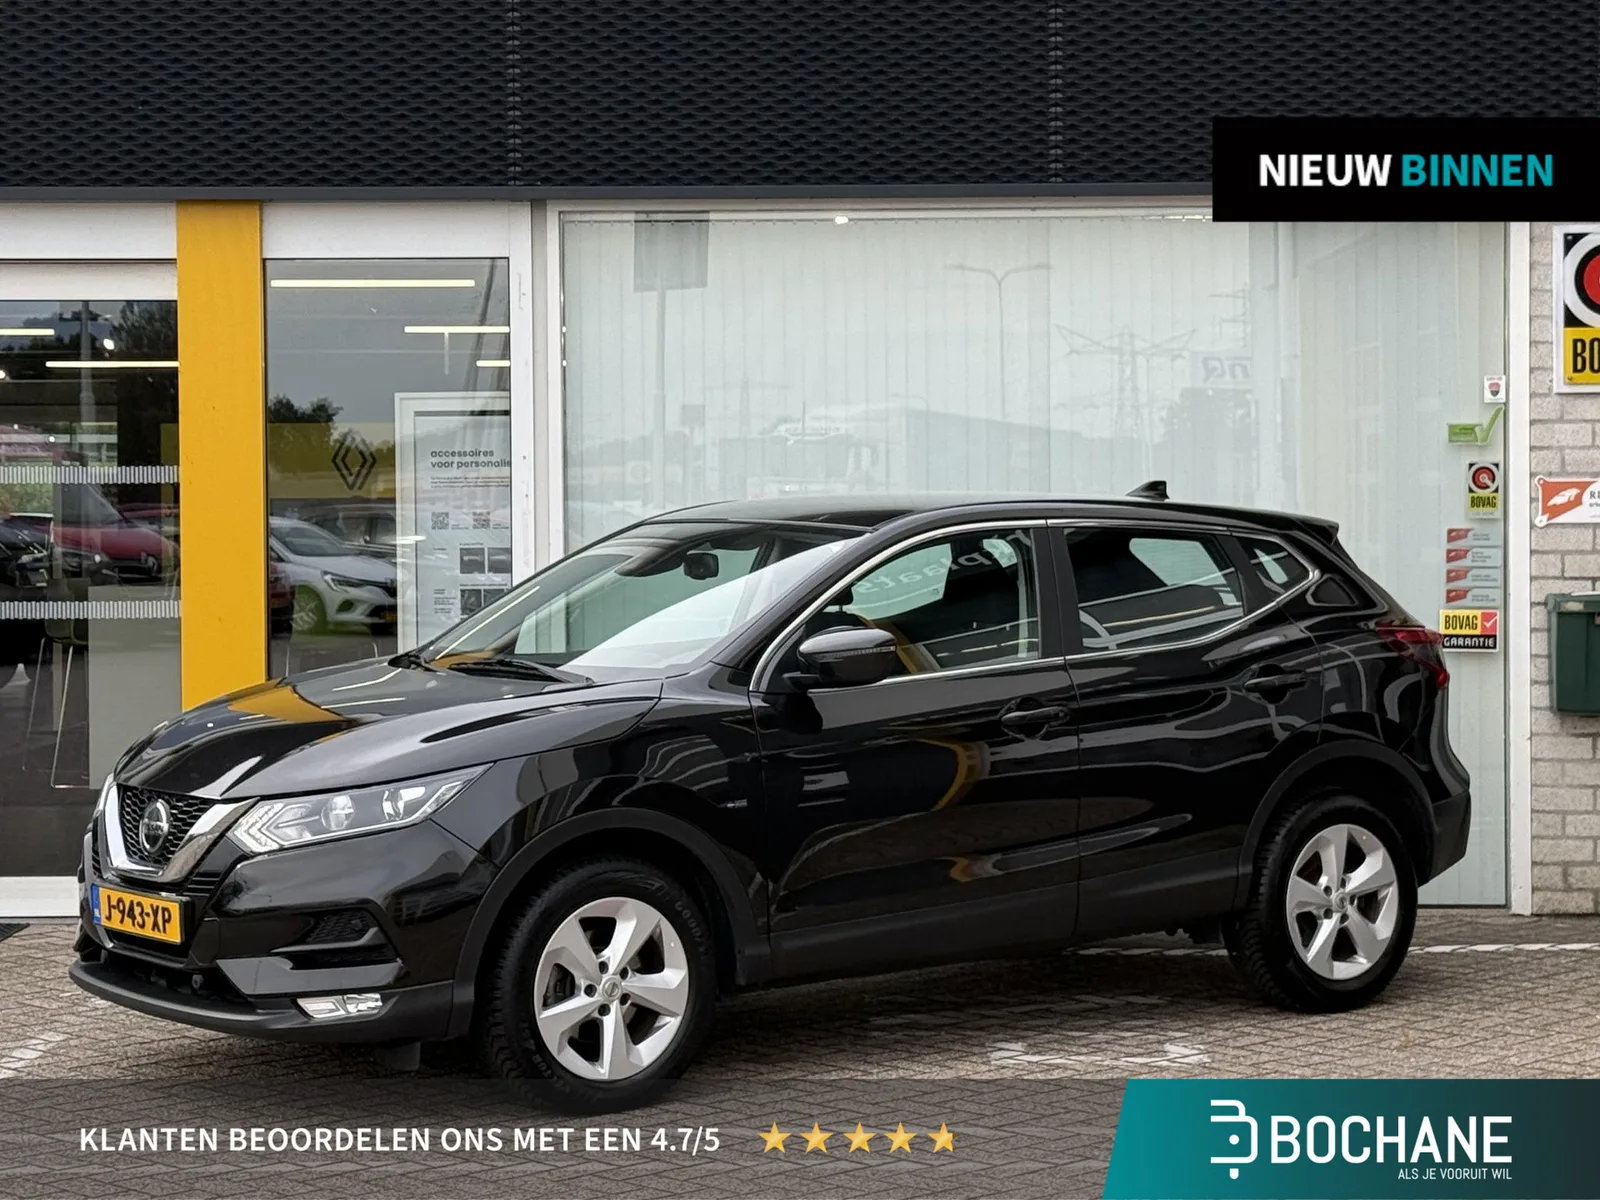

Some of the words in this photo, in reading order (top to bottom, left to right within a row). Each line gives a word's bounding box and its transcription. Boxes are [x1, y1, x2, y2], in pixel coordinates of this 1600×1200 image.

[430, 449, 494, 458] accessoires
[430, 460, 454, 469] voor
[1470, 496, 1497, 509] BOVAG
[1444, 614, 1478, 631] BOVAG
[1443, 637, 1495, 648] GARANTIE
[105, 894, 172, 934] J-943-XP
